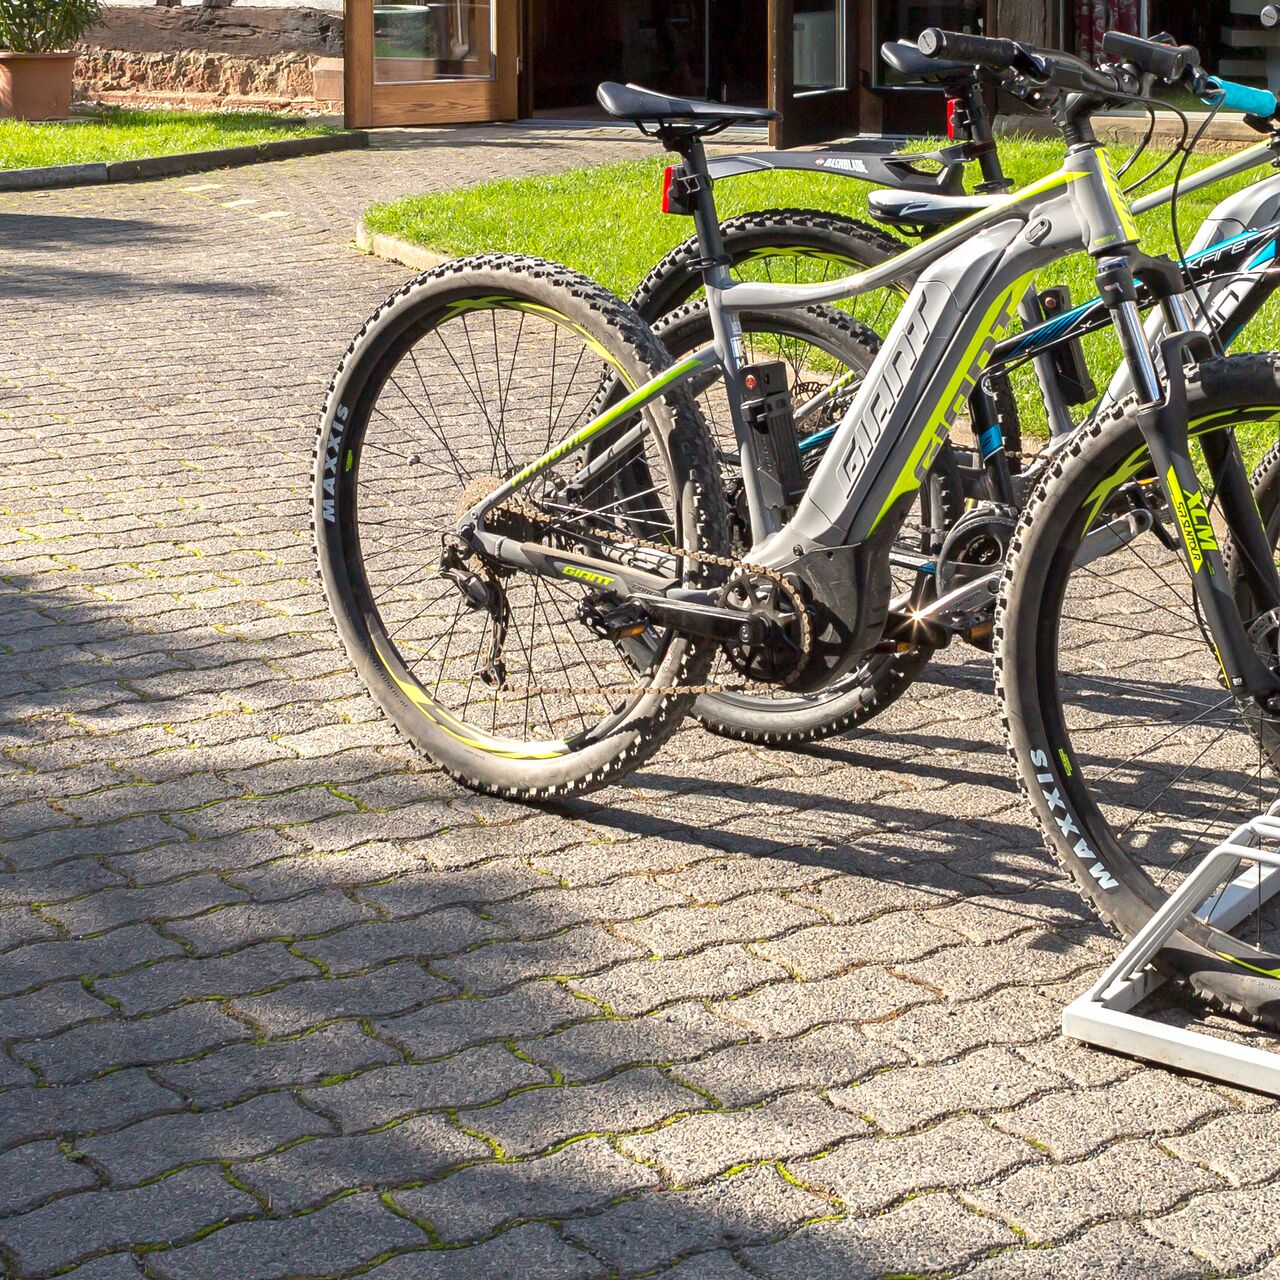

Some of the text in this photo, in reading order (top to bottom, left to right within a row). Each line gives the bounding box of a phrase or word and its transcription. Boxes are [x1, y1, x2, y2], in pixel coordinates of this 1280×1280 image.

[836, 289, 930, 499] GIANT
[323, 403, 349, 523] MAXXIS
[1182, 489, 1219, 551] XCM
[562, 564, 615, 586] GIANT
[1030, 748, 1120, 890] MAXXIS
